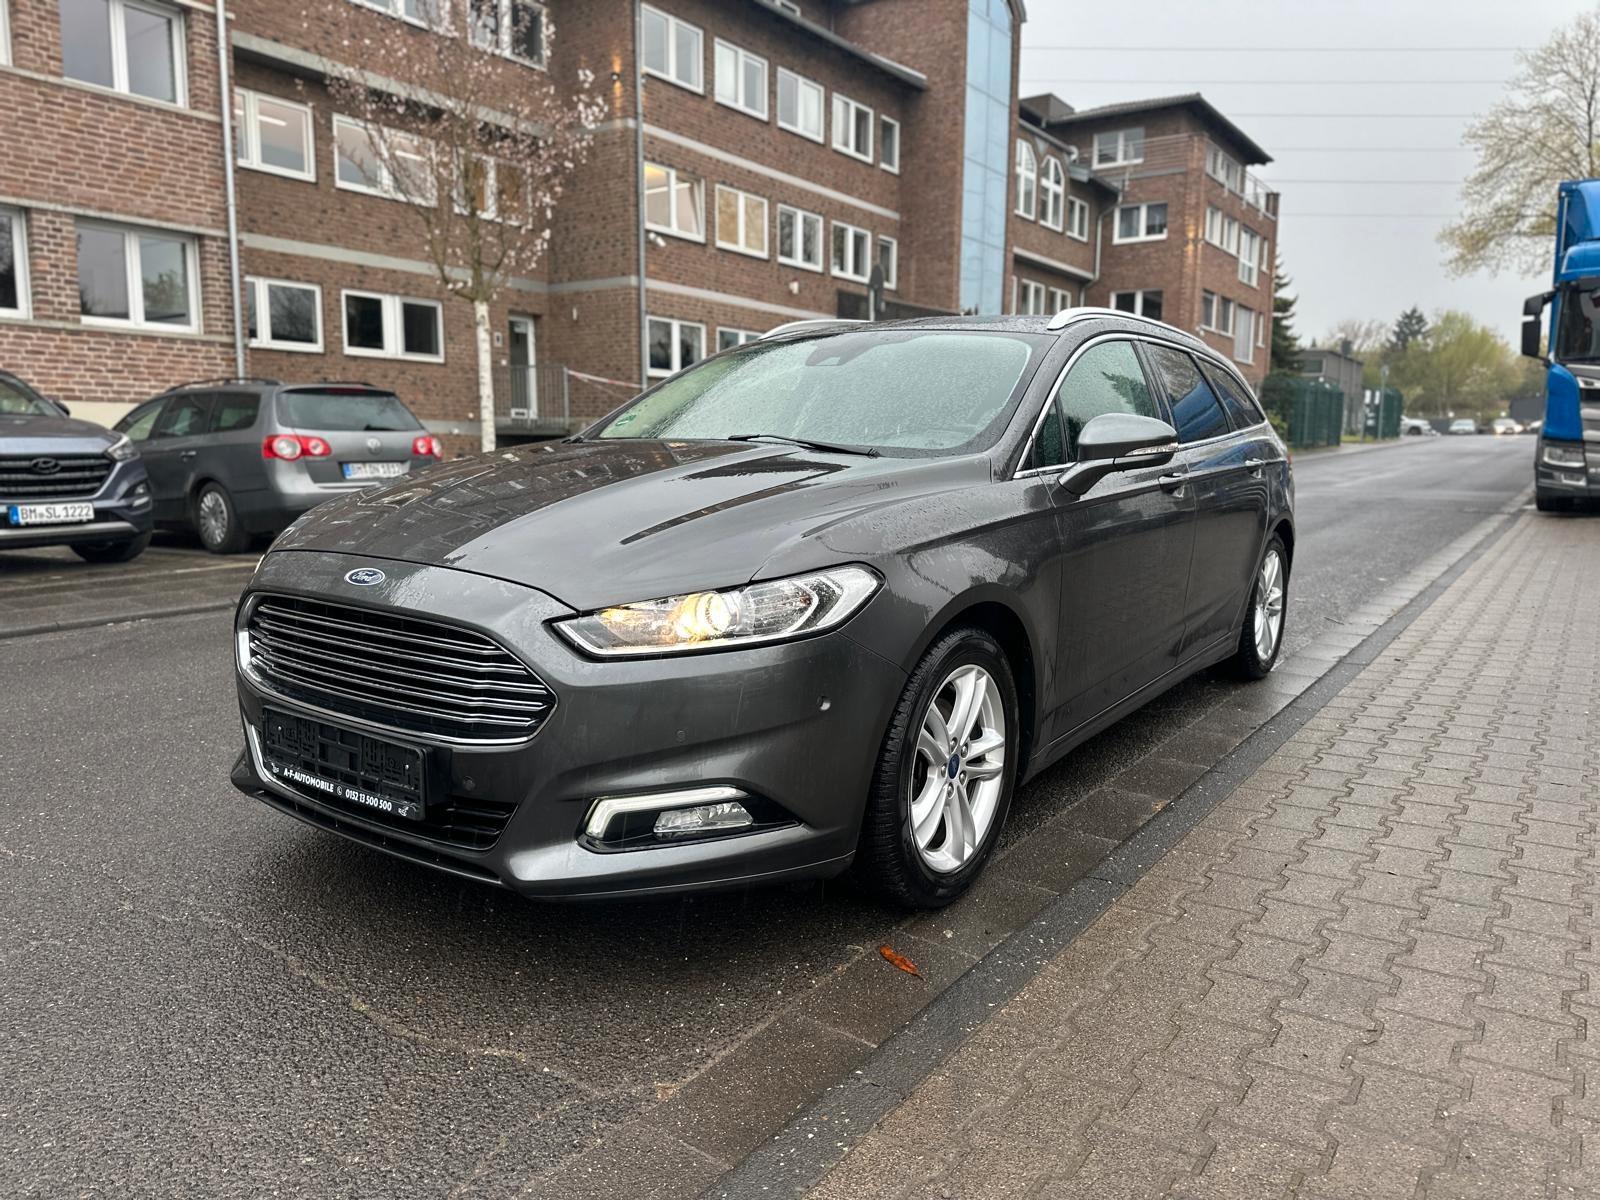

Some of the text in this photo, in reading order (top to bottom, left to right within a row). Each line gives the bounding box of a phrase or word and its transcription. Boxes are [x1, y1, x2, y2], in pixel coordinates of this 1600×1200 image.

[20, 505, 91, 520] BM SL 1222
[350, 570, 382, 583] Ford
[283, 767, 334, 793] A-F-AUTOMOBILE
[345, 788, 359, 801] 0152
[359, 793, 366, 804] 13
[365, 795, 379, 808] 500
[379, 799, 392, 812] 500
